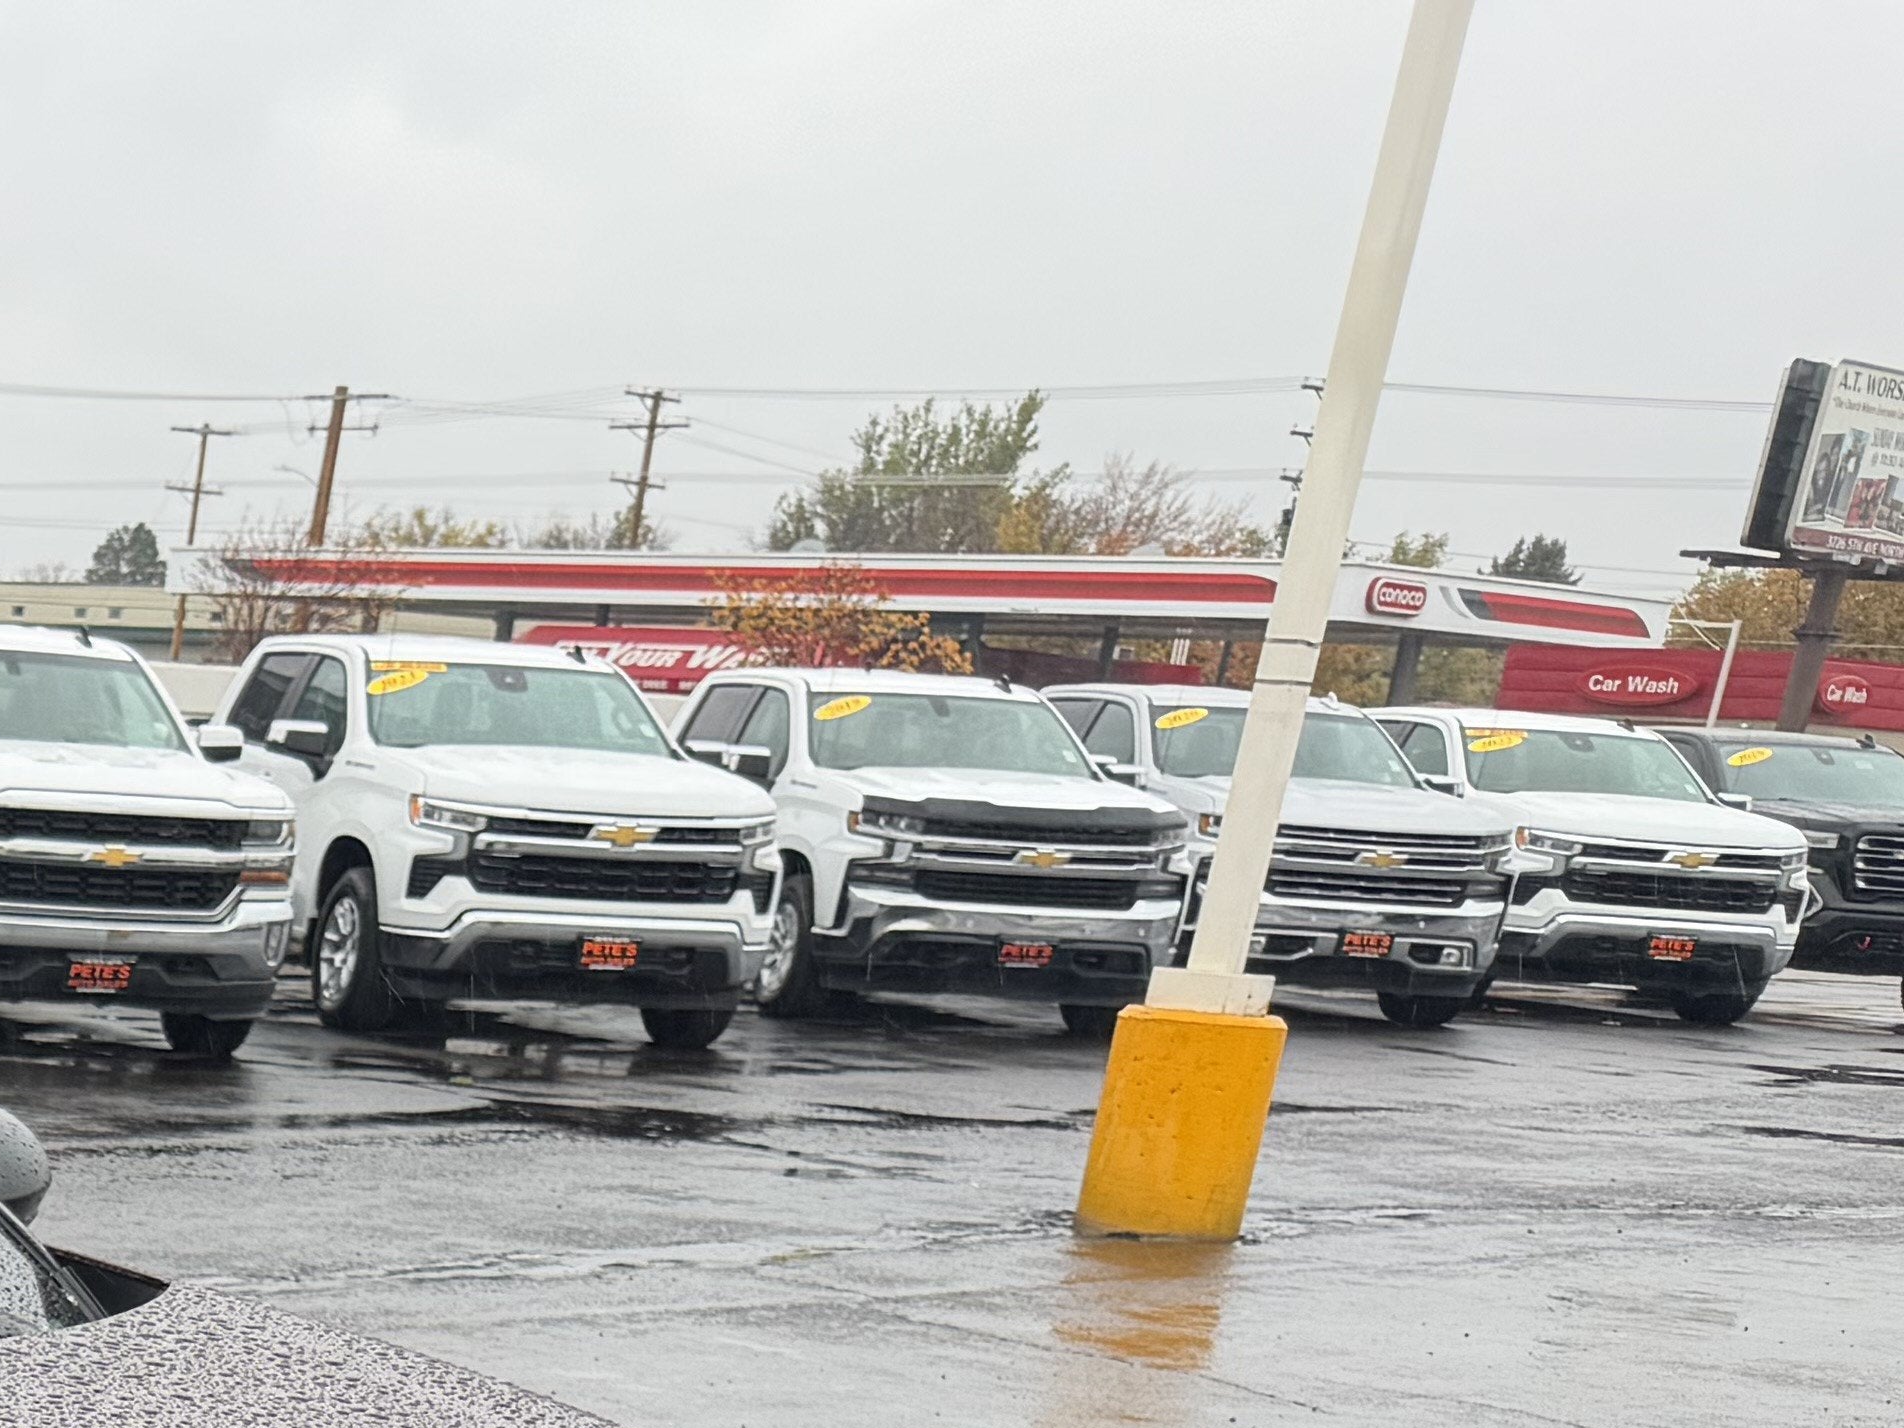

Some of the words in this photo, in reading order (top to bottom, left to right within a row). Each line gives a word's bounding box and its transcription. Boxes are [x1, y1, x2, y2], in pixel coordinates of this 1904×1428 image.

[1838, 369, 1861, 393] A.T.
[1866, 373, 1904, 402] WORS
[1588, 675, 1622, 692] Car
[1627, 676, 1679, 695] Wash
[70, 964, 131, 978] PETE'S
